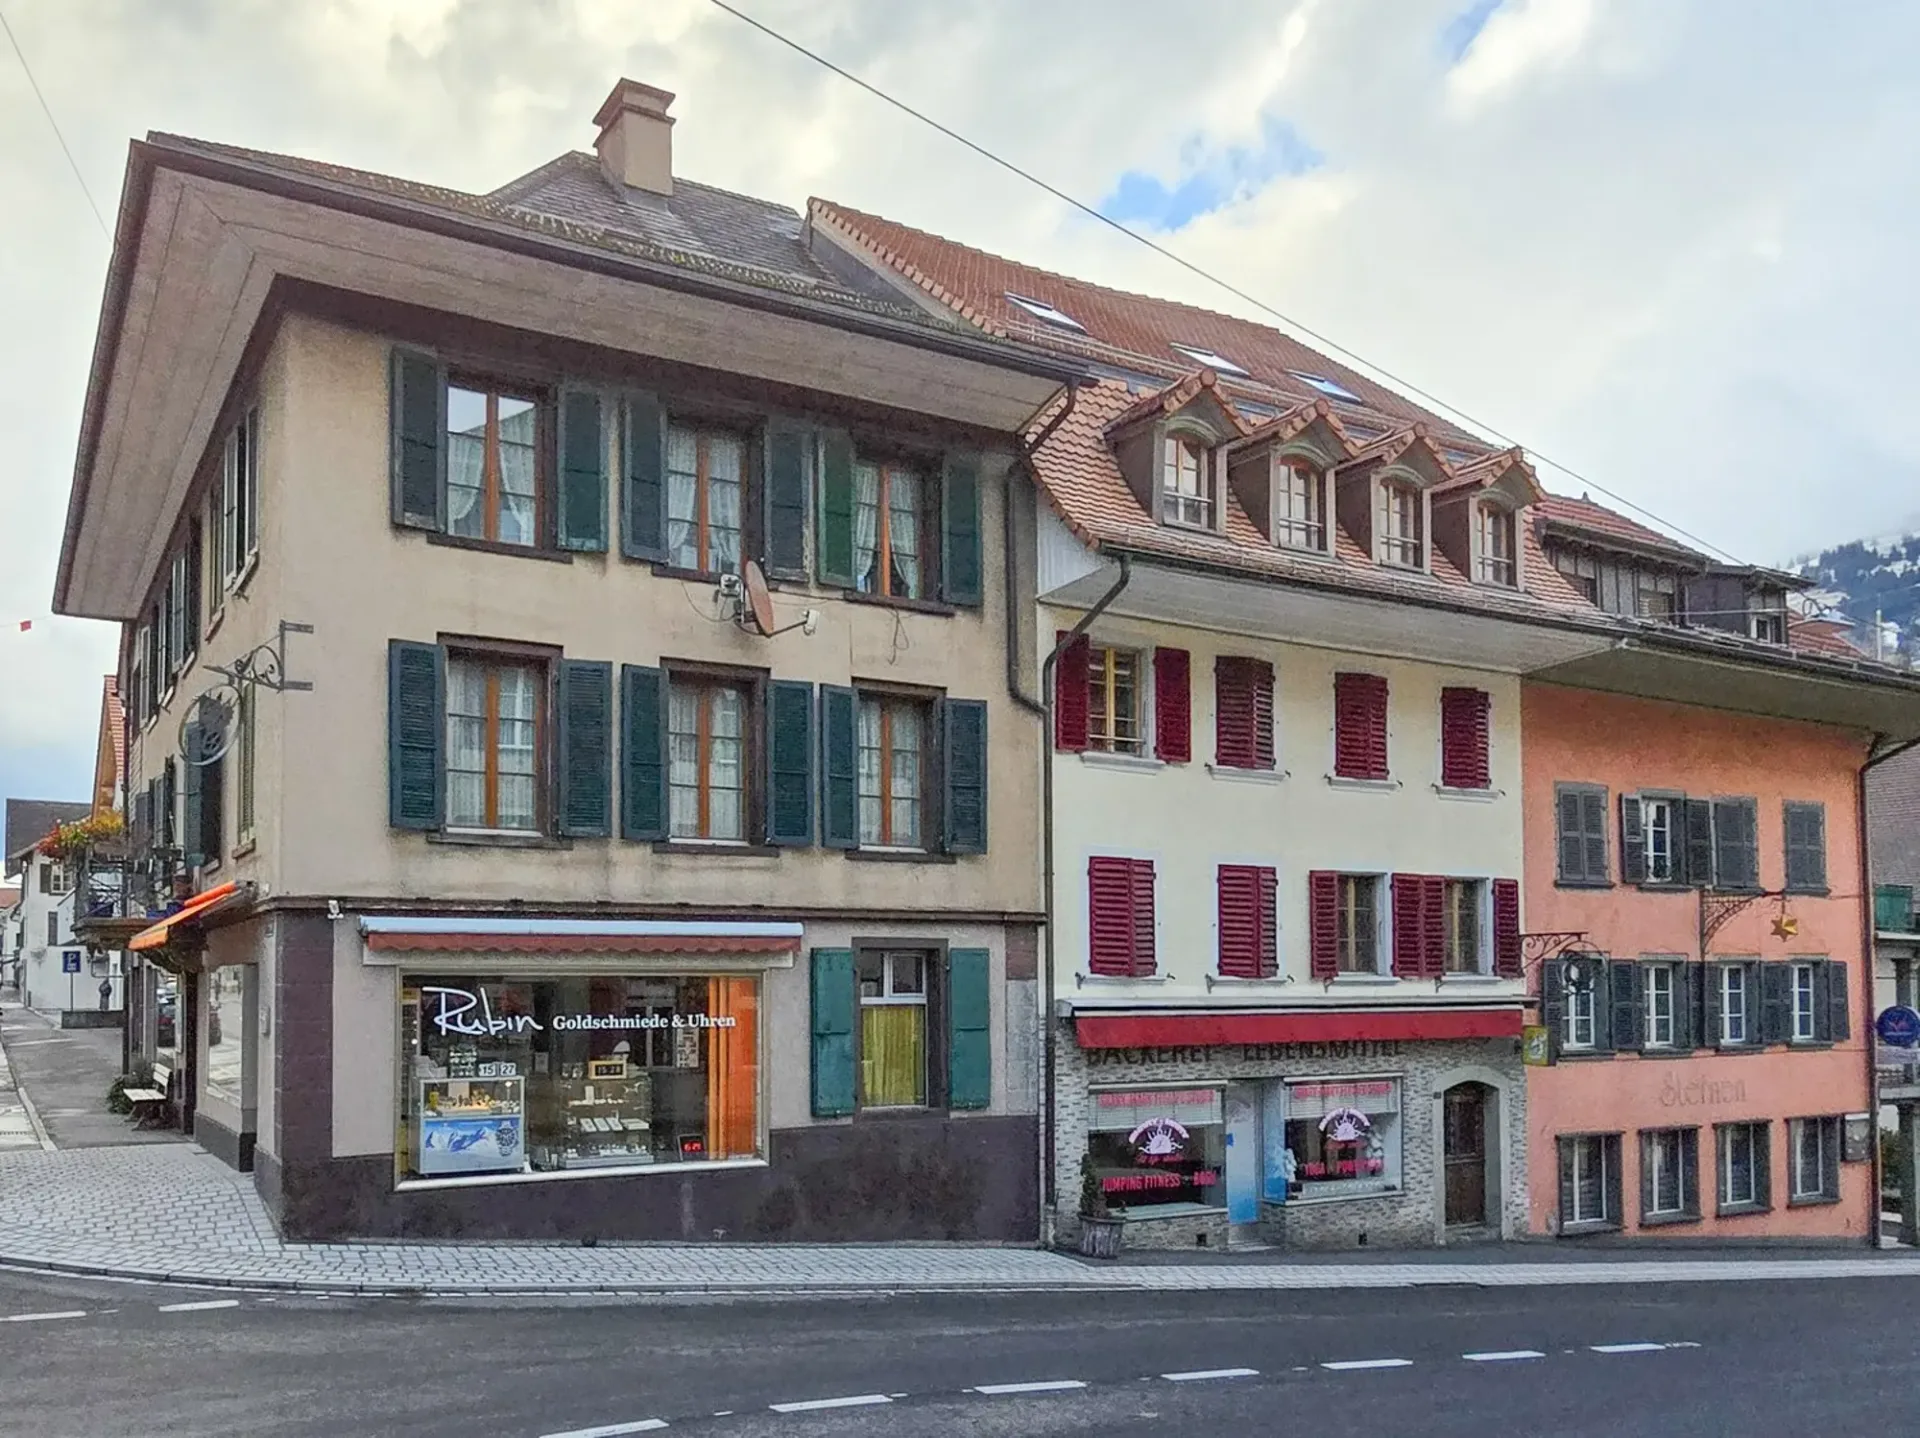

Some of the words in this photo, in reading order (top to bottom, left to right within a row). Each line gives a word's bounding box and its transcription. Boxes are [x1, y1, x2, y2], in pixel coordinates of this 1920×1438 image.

[422, 986, 543, 1036] Rubin
[552, 1013, 668, 1030] Goldschmiede
[671, 1013, 688, 1028] &
[688, 1012, 736, 1028] Uhren
[1144, 1173, 1181, 1189] FITNESS
